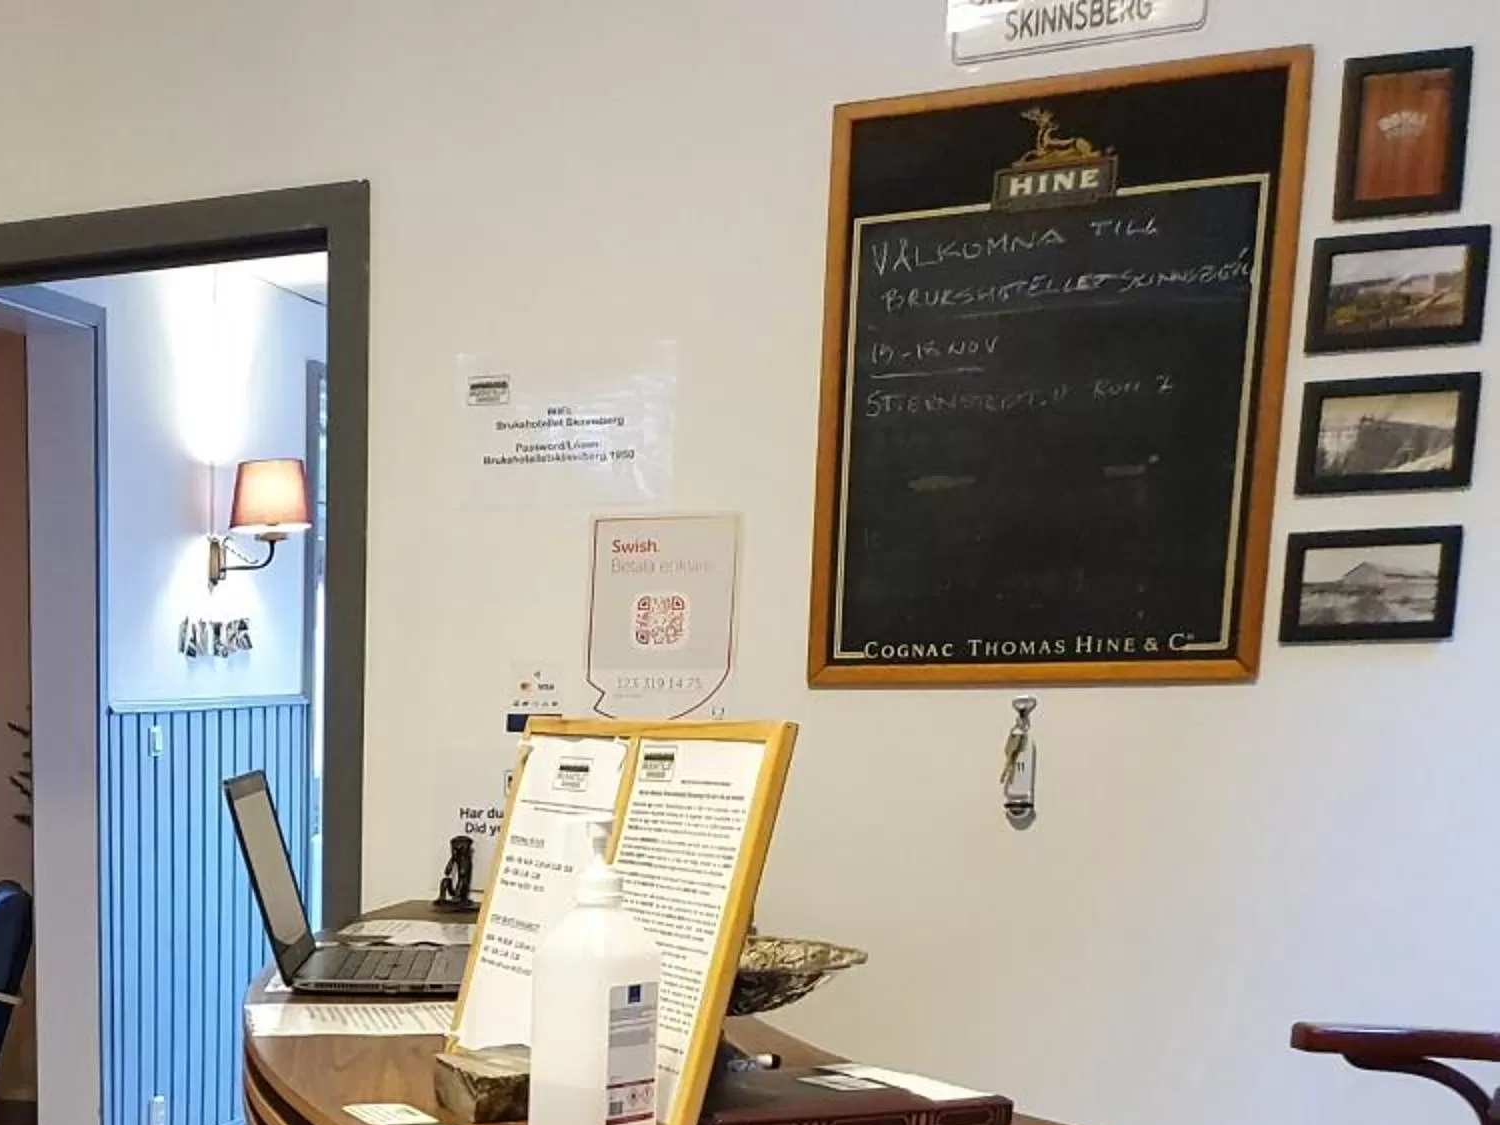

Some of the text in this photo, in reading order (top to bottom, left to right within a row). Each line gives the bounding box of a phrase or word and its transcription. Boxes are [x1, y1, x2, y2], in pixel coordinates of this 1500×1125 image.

[1005, 0, 1152, 40] SKINNSBERG
[1009, 168, 1100, 197] HINE
[611, 537, 658, 553] Swish
[1144, 637, 1160, 652] &
[459, 807, 504, 819] Har du
[465, 821, 487, 834] Did
